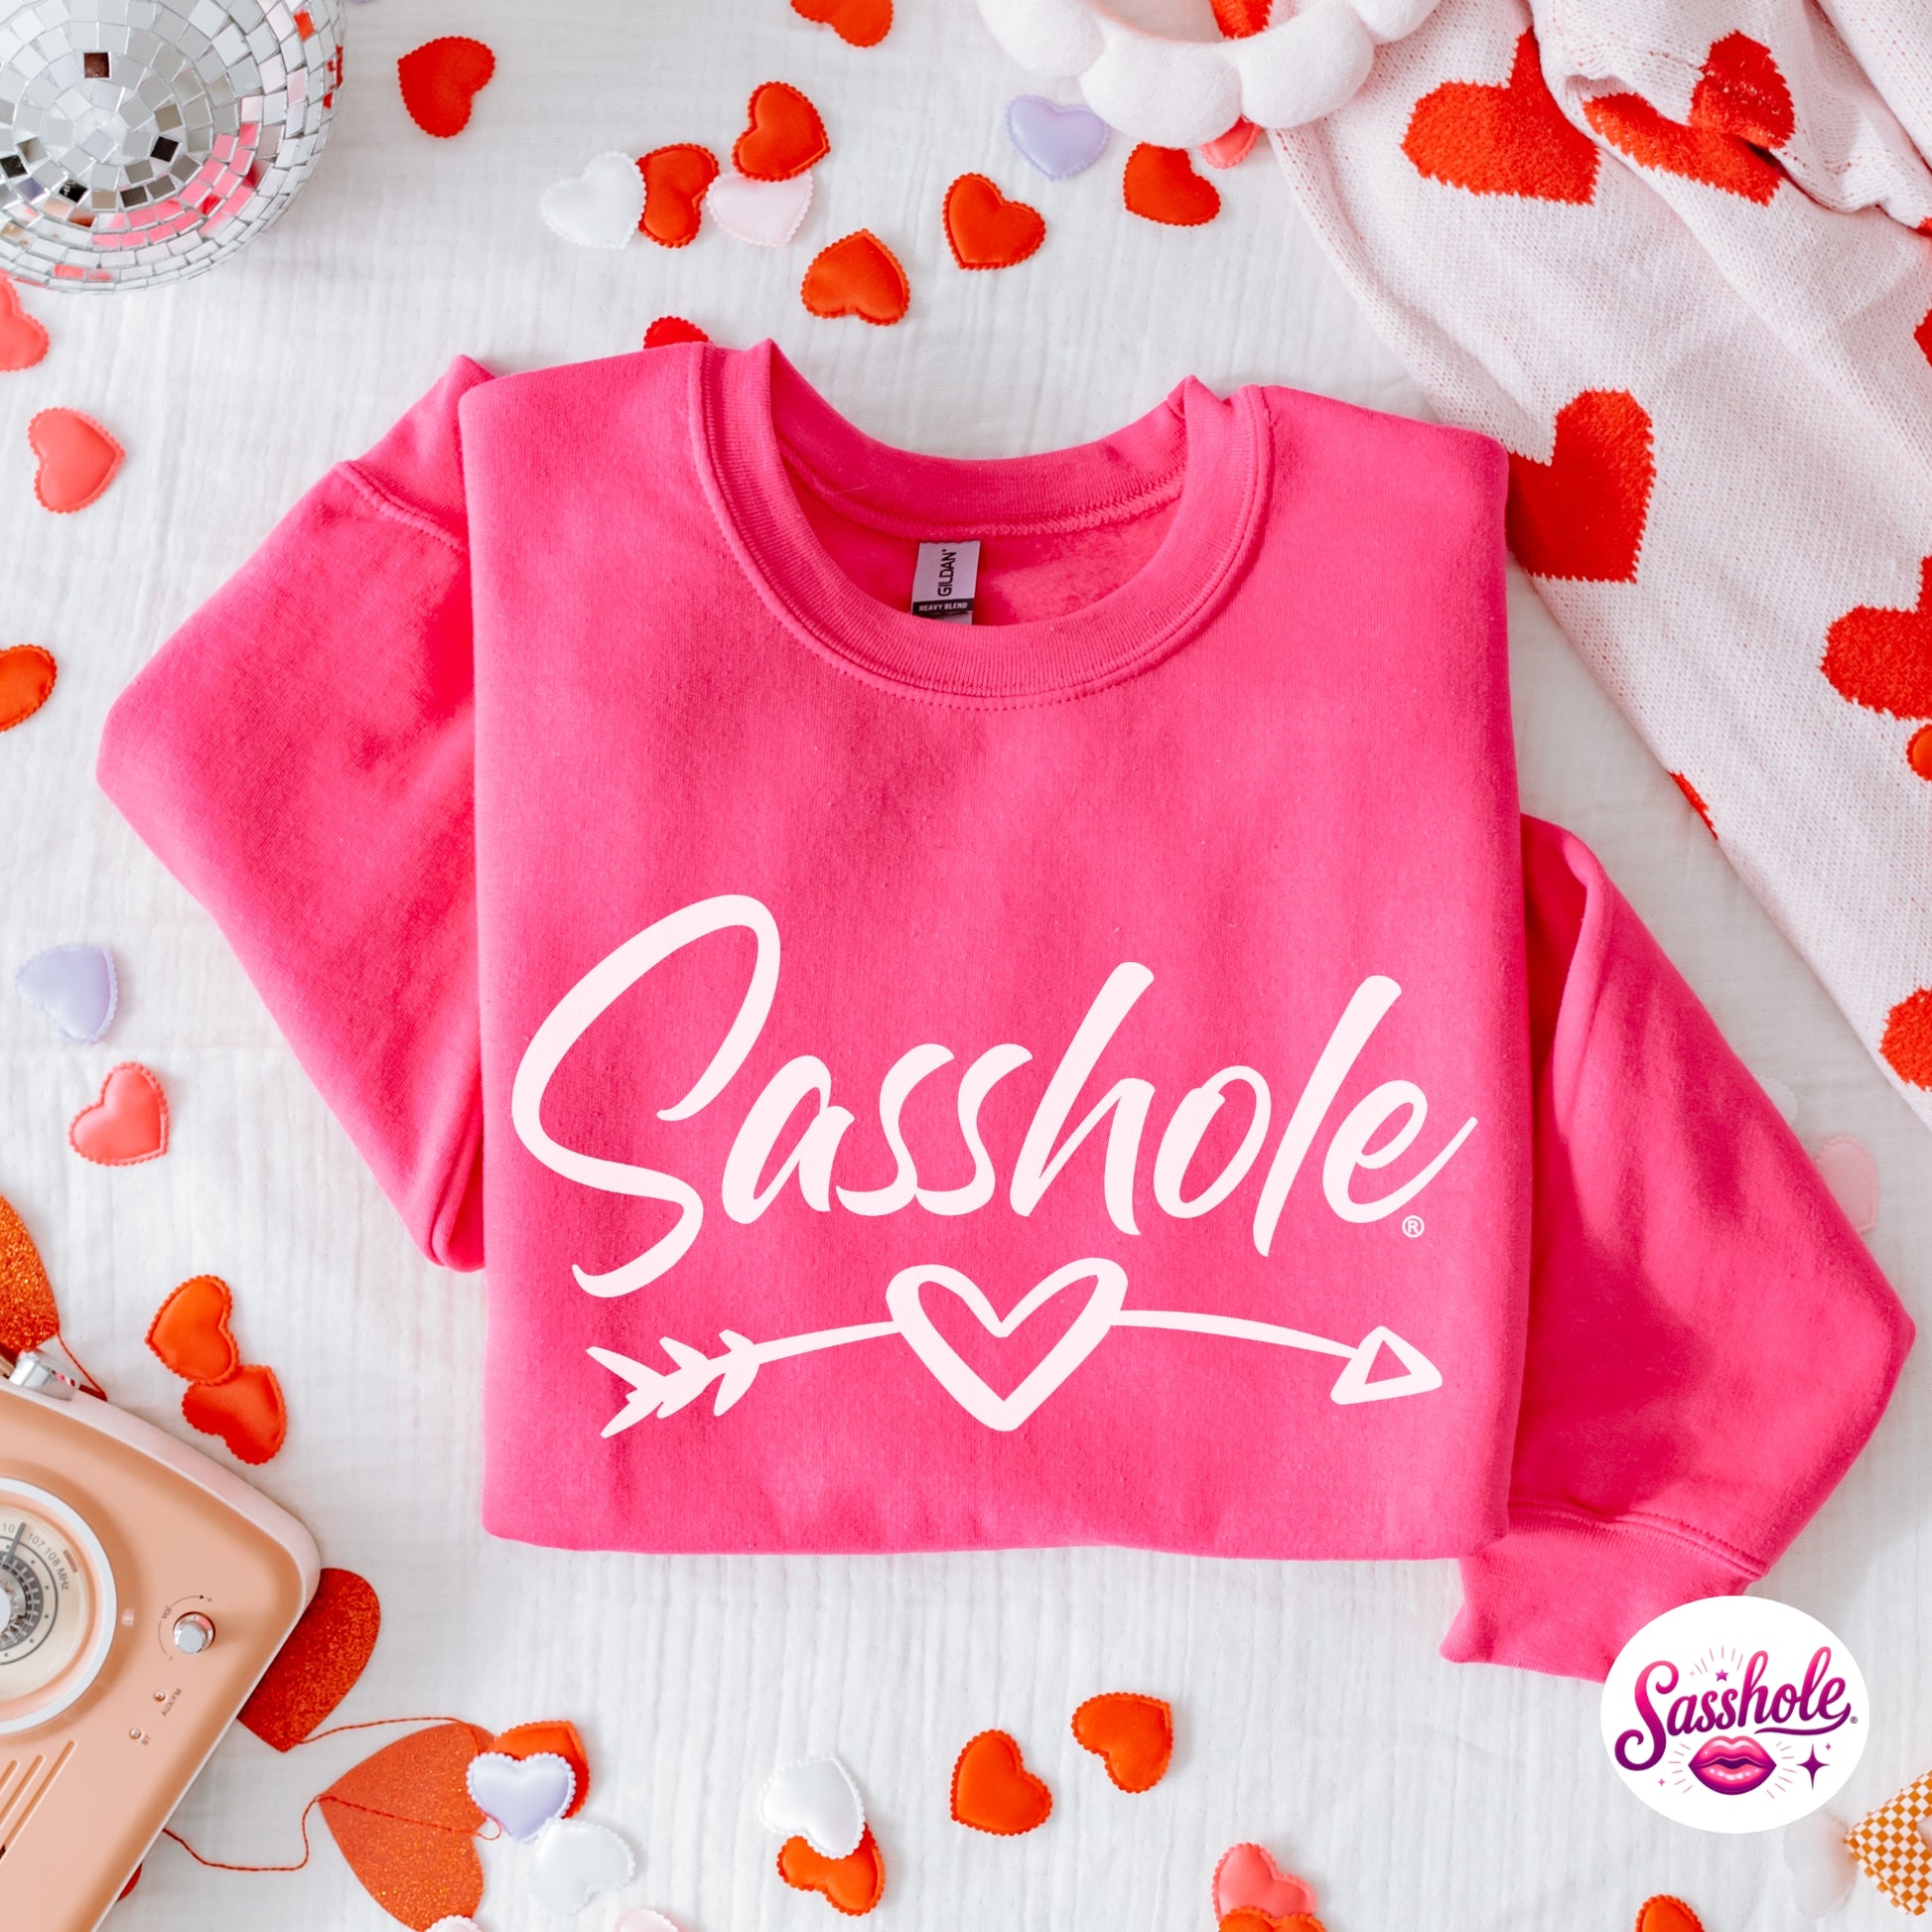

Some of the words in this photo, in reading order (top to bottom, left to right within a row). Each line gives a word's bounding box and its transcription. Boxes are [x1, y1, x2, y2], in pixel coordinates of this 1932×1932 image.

[937, 551, 957, 597] GILDAN
[511, 895, 1478, 1298] Sasshole
[28, 1532, 46, 1548] 107
[45, 1548, 62, 1567] 108
[57, 1568, 69, 1591] MHz
